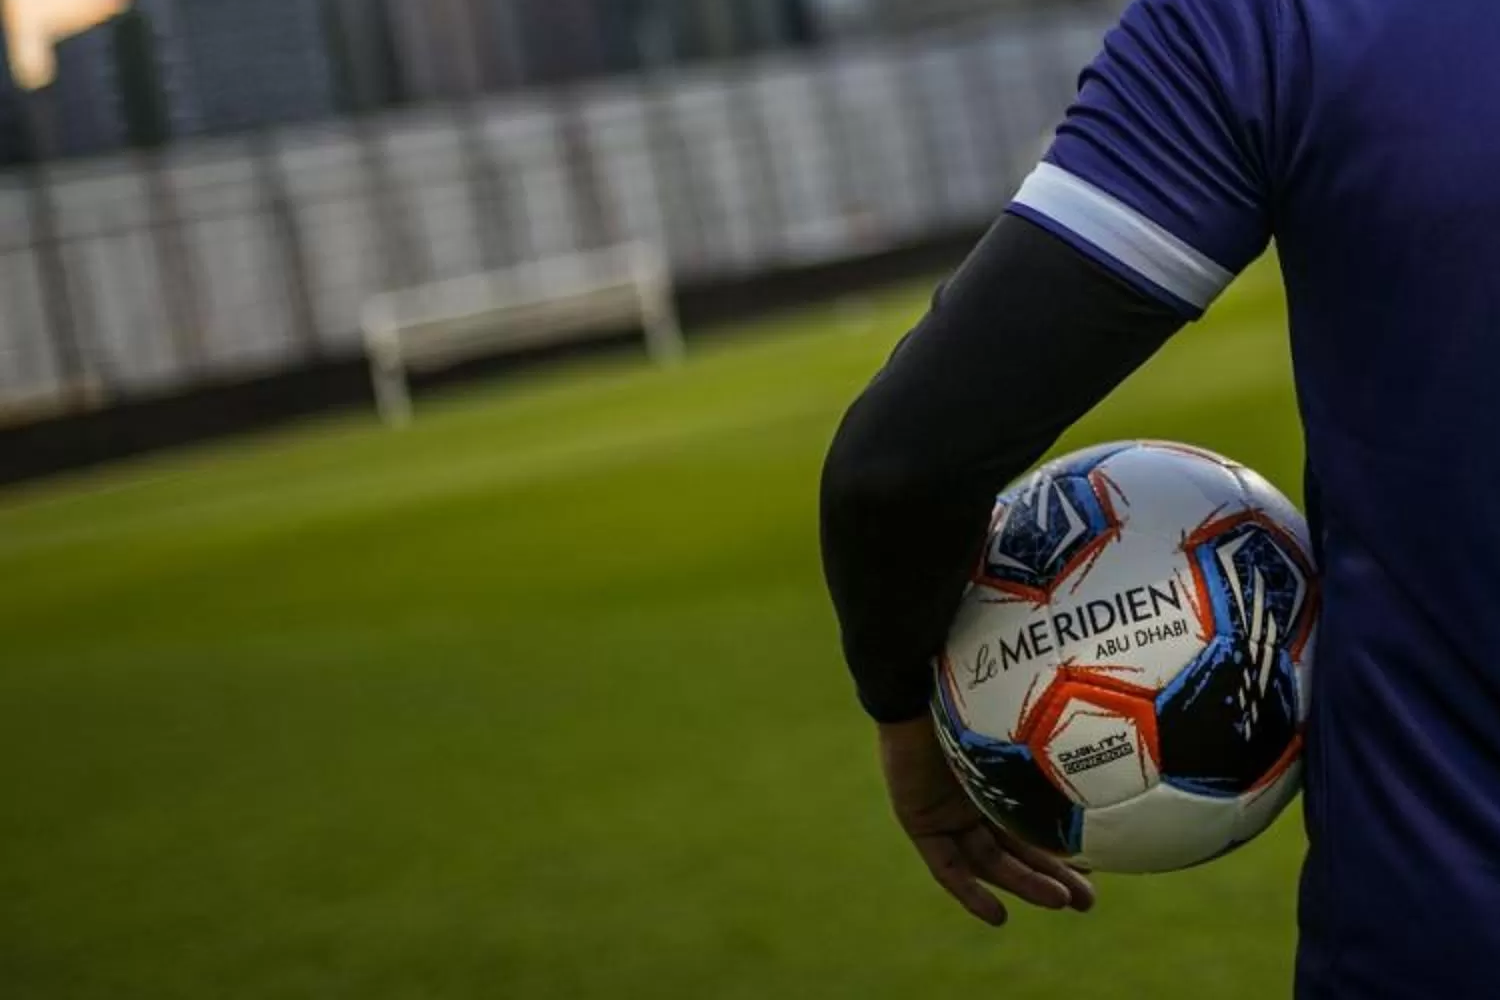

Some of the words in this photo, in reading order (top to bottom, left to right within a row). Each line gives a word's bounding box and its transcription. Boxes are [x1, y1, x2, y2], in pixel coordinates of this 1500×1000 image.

[968, 644, 999, 690] Le
[999, 580, 1184, 671] MERIDIEN
[1095, 637, 1131, 660] ABU
[1135, 618, 1189, 648] DHABI
